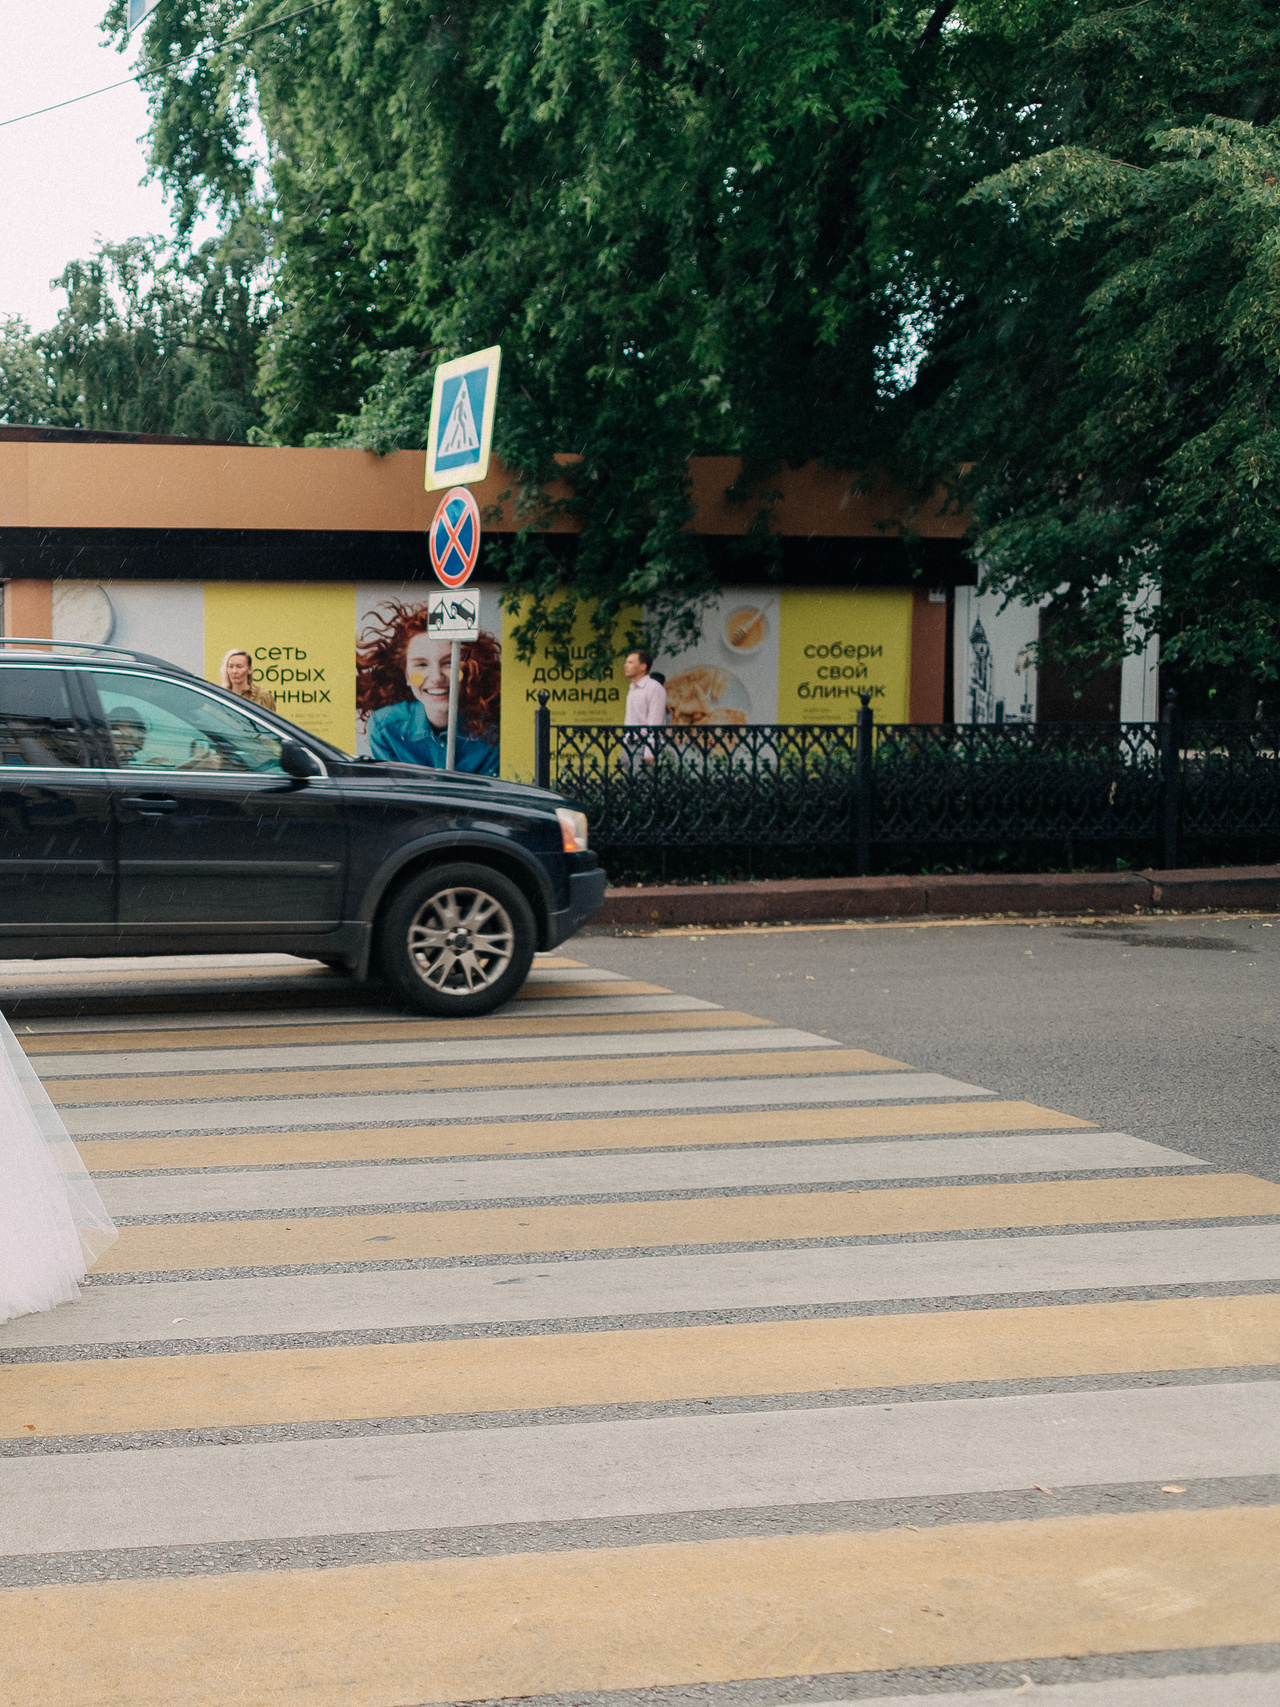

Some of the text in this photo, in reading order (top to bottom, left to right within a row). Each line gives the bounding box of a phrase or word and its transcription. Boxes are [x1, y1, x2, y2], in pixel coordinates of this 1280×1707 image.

[254, 646, 307, 660] сеть
[804, 641, 882, 660] собери
[252, 664, 325, 685] обрых
[817, 663, 868, 680] свой
[797, 682, 886, 699] блинчик
